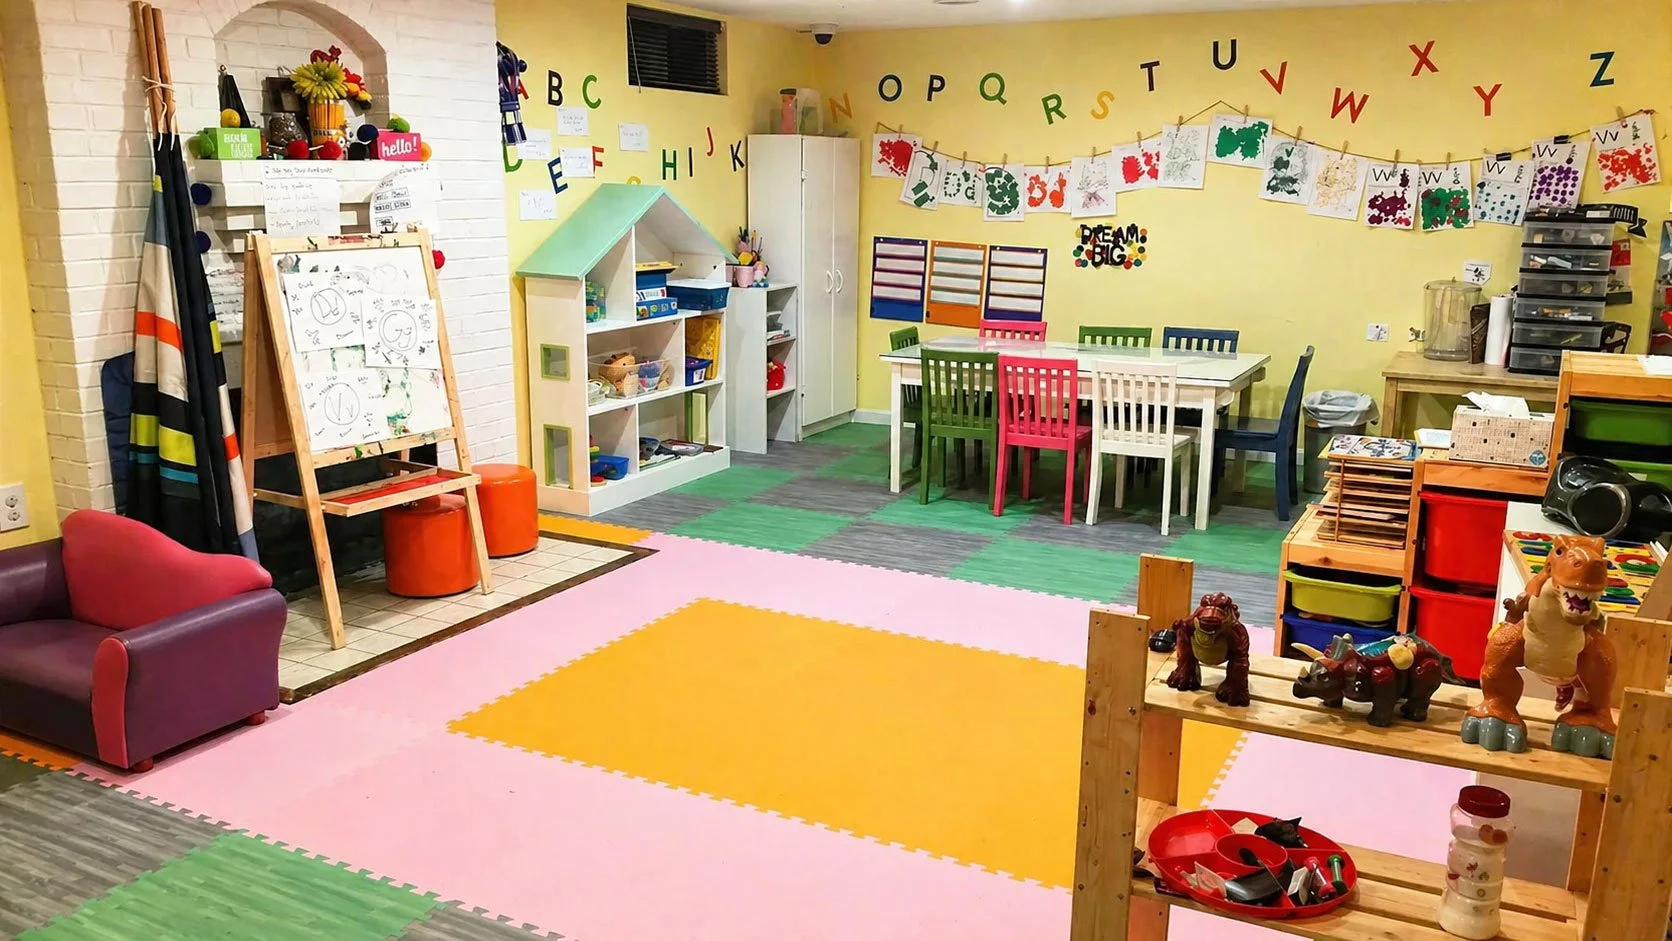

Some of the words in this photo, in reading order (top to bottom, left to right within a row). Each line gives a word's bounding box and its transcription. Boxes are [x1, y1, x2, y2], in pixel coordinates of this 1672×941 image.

[547, 70, 563, 107] B
[582, 74, 602, 109] C
[829, 92, 853, 123] N
[878, 74, 902, 102] O
[926, 74, 946, 102] P
[979, 72, 1007, 105] Q
[1042, 93, 1067, 125] R
[1090, 90, 1116, 120] S
[1140, 60, 1160, 92] T
[1212, 38, 1237, 70] U
[1259, 61, 1288, 95] V
[1330, 87, 1369, 124] W
[1408, 40, 1439, 77] X
[1473, 83, 1502, 117] Y
[1589, 51, 1615, 88] Z
[381, 136, 417, 158] hello!
[547, 156, 568, 194] E
[592, 145, 604, 177] F
[662, 149, 677, 181] H
[688, 147, 693, 177] I
[706, 127, 714, 157] J
[730, 140, 745, 172] K
[1080, 223, 1139, 245] DREAM
[1092, 244, 1127, 268] BIG
